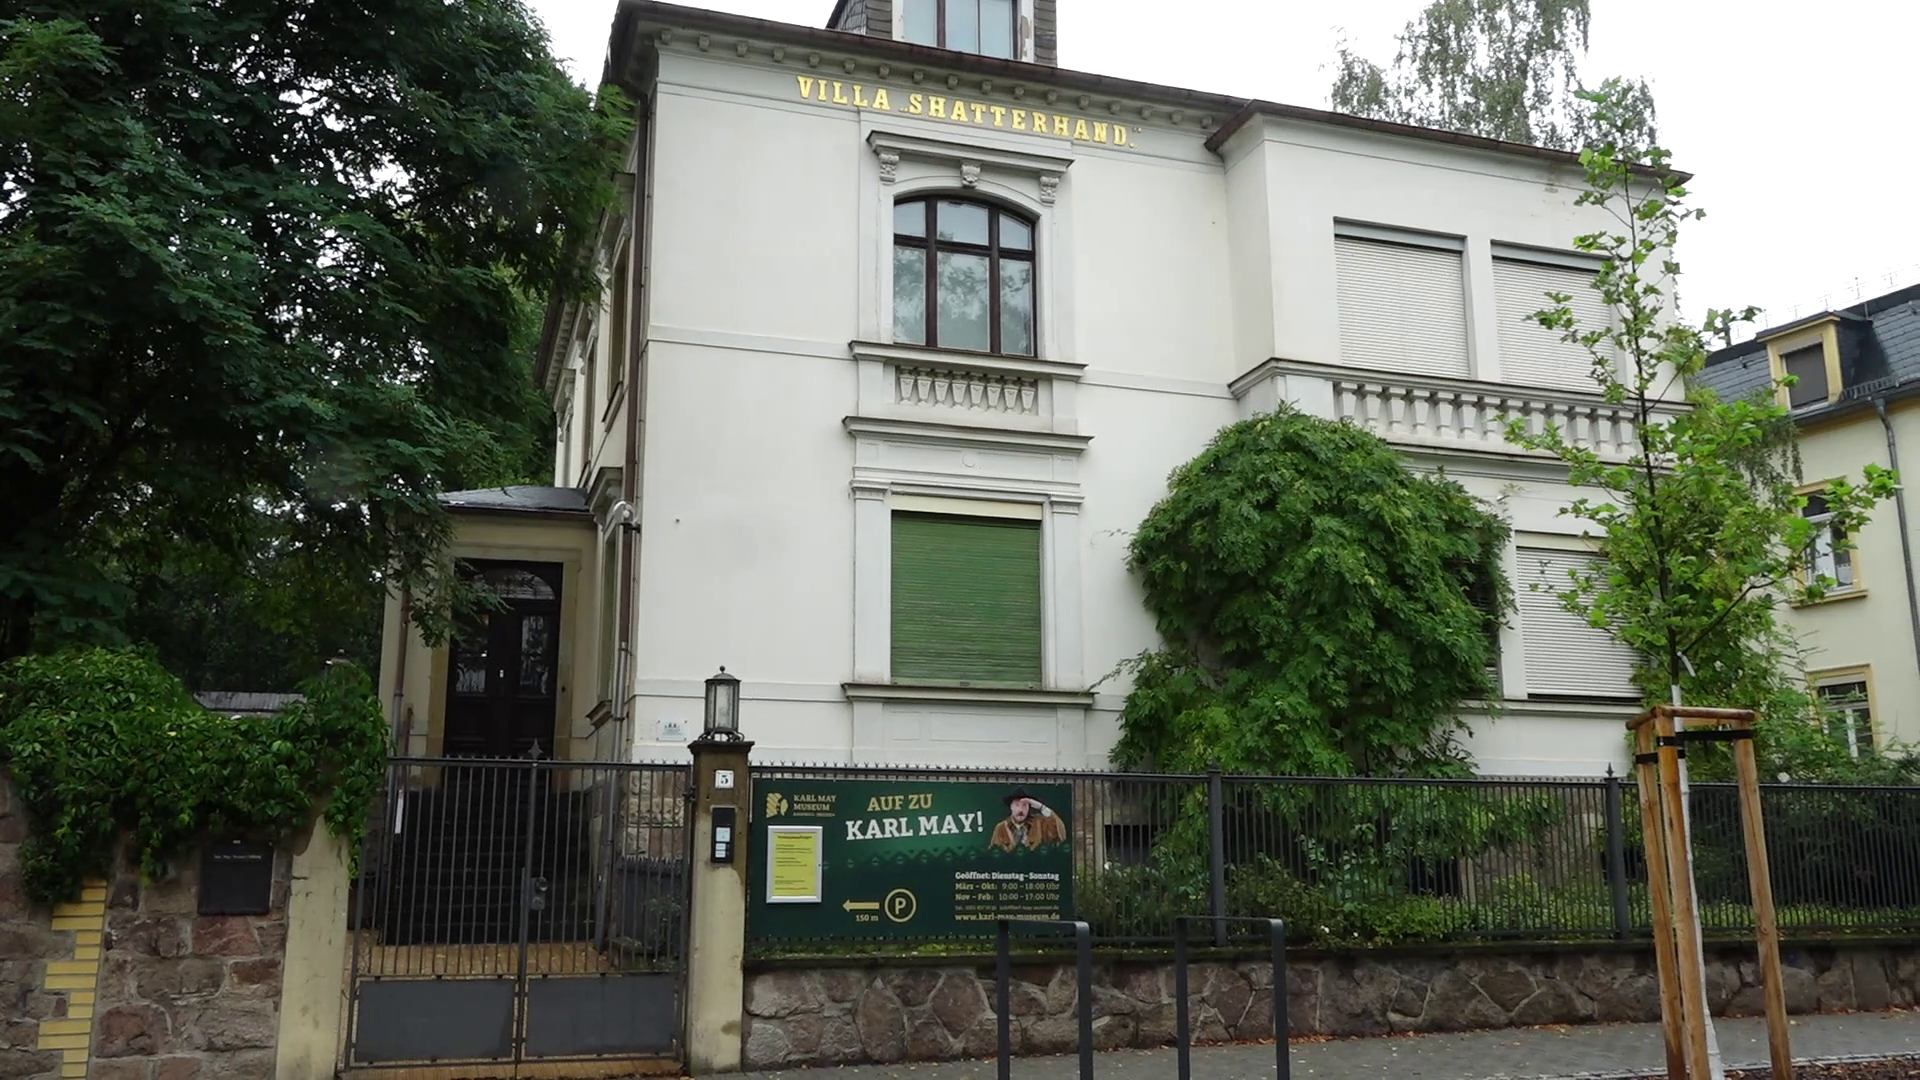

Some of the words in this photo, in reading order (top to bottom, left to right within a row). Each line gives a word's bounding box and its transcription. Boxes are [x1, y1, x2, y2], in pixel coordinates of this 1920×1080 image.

[796, 76, 891, 110] VILLA
[720, 774, 729, 785] 5
[793, 794, 817, 802] KARL
[866, 795, 904, 812] AUF
[908, 793, 933, 810] ZU
[793, 803, 830, 811] MUSEUM
[845, 817, 914, 841] KARL
[918, 810, 983, 836] MAY!
[955, 872, 991, 880] Geöffnet:
[1046, 882, 1060, 890] Uhr
[1046, 893, 1060, 901] Uhr
[895, 897, 907, 915] P
[855, 914, 869, 922] 150
